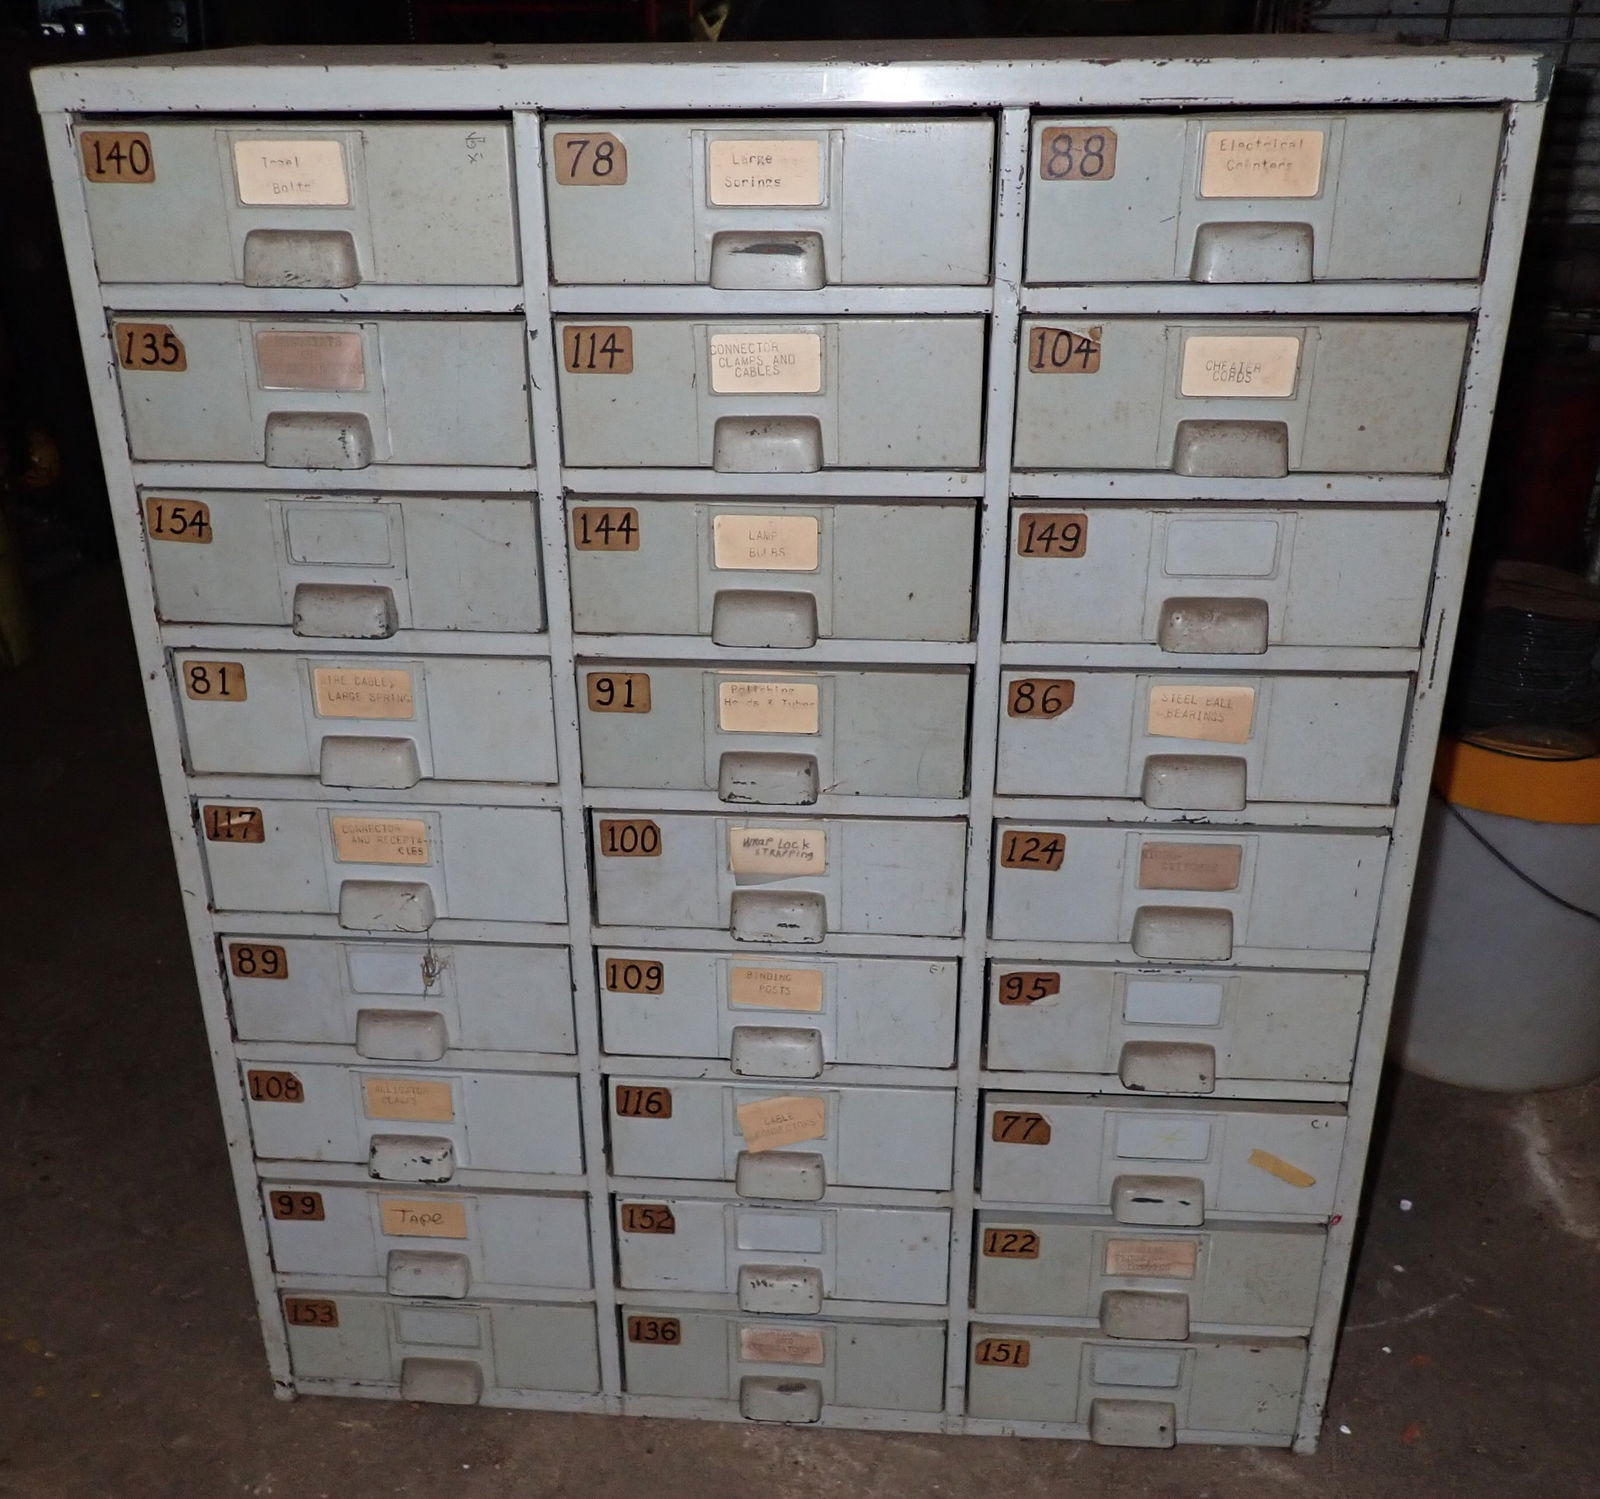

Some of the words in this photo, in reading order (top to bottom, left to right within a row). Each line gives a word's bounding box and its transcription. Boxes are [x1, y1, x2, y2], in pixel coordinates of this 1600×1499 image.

[94, 139, 150, 175] 140
[566, 140, 615, 178] 78
[1046, 134, 1104, 178] 88
[125, 331, 179, 364] 135
[571, 332, 624, 368] 114
[1034, 332, 1098, 368] 104
[154, 505, 209, 537] 154
[581, 513, 637, 544] 144
[1023, 520, 1081, 553] 149
[191, 666, 230, 695] 81
[596, 677, 634, 708] 91
[1013, 682, 1061, 714] 86
[212, 810, 257, 839] 117
[608, 825, 658, 853] 100
[1006, 836, 1063, 864] 124
[238, 947, 279, 975] 89
[609, 963, 661, 992] 109
[1006, 977, 1053, 1001] 95
[253, 1076, 300, 1100] 108
[621, 1089, 662, 1115] 116
[1001, 1115, 1042, 1141] 77
[277, 1194, 316, 1216] 99
[627, 1208, 671, 1230] 152
[988, 1231, 1036, 1253] 122
[292, 1303, 334, 1323] 153
[634, 1321, 678, 1341] 136
[982, 1342, 1022, 1365] 151
